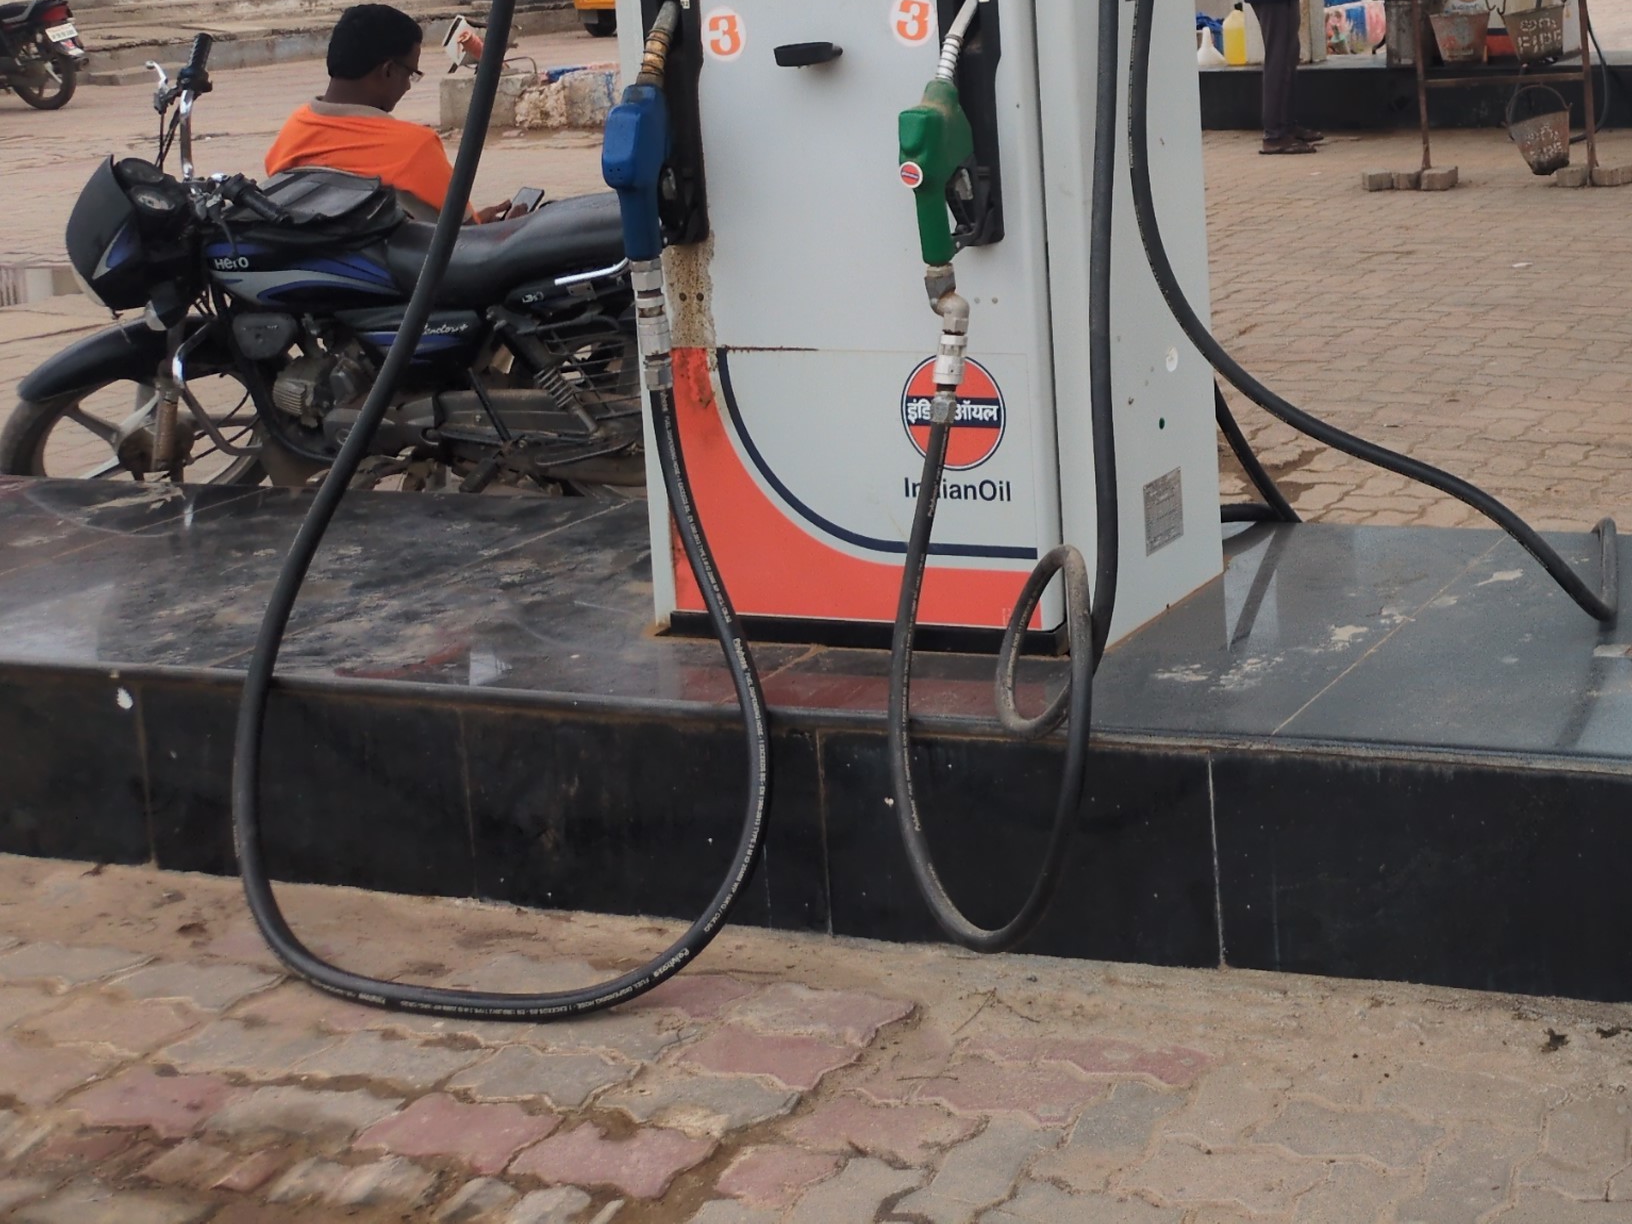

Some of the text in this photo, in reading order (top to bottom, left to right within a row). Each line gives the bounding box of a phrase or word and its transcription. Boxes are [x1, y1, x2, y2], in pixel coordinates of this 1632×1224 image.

[709, 14, 741, 56] 3
[214, 256, 250, 270] Hero
[907, 398, 999, 424] इंडिऑयल
[904, 477, 1012, 502] InianOil
[744, 671, 754, 686] FUEL
[754, 718, 764, 736] HOSE
[758, 742, 766, 772] EXCEEDS
[749, 825, 760, 843] TYPE
[651, 946, 691, 981] Polyhose
[576, 999, 595, 1009] HOSE
